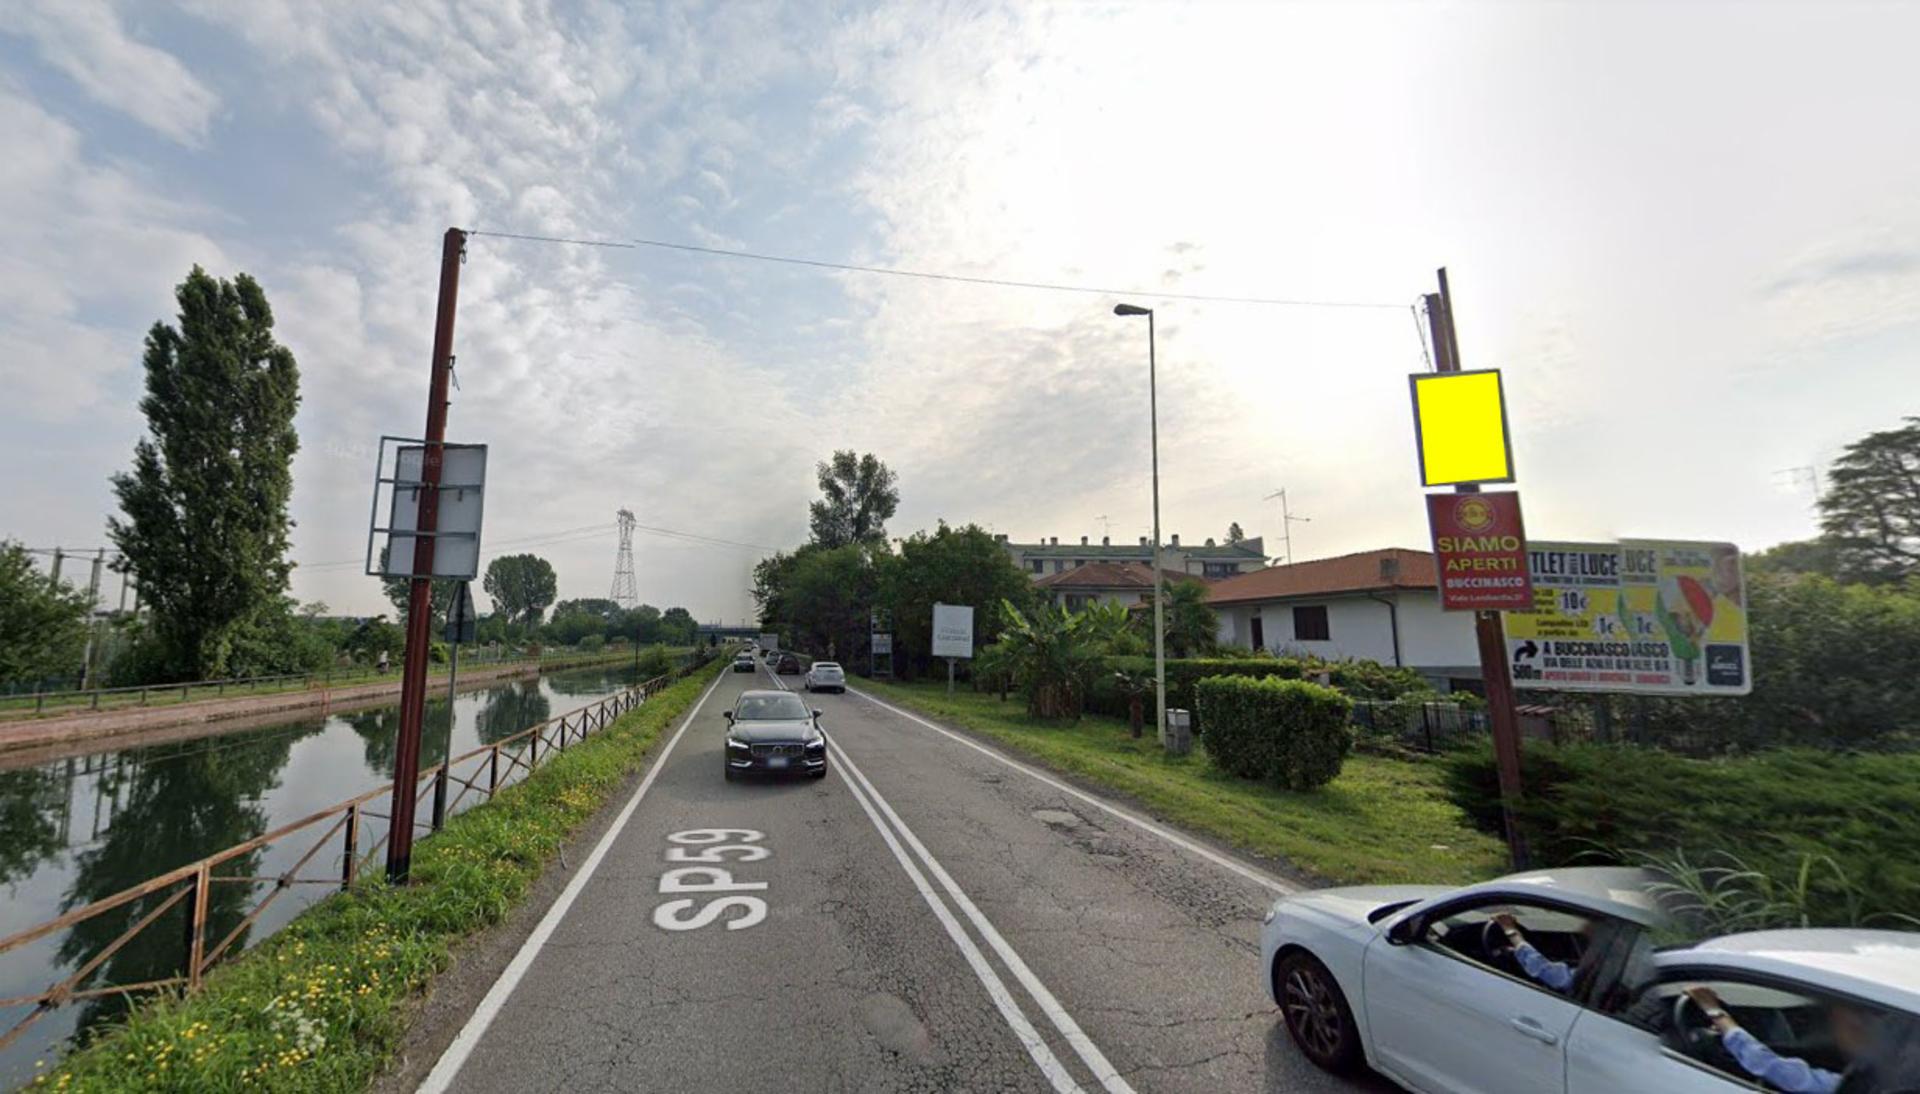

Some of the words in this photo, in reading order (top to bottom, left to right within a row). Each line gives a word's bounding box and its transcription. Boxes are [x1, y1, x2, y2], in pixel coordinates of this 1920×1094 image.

[1437, 536, 1520, 552] SIAMO
[1446, 557, 1518, 571] APERTI
[1580, 553, 1618, 575] LUCE
[1446, 577, 1525, 588] BUCCINASCO
[1554, 642, 1630, 656] BUCCINASCO
[653, 828, 773, 931] SP59
